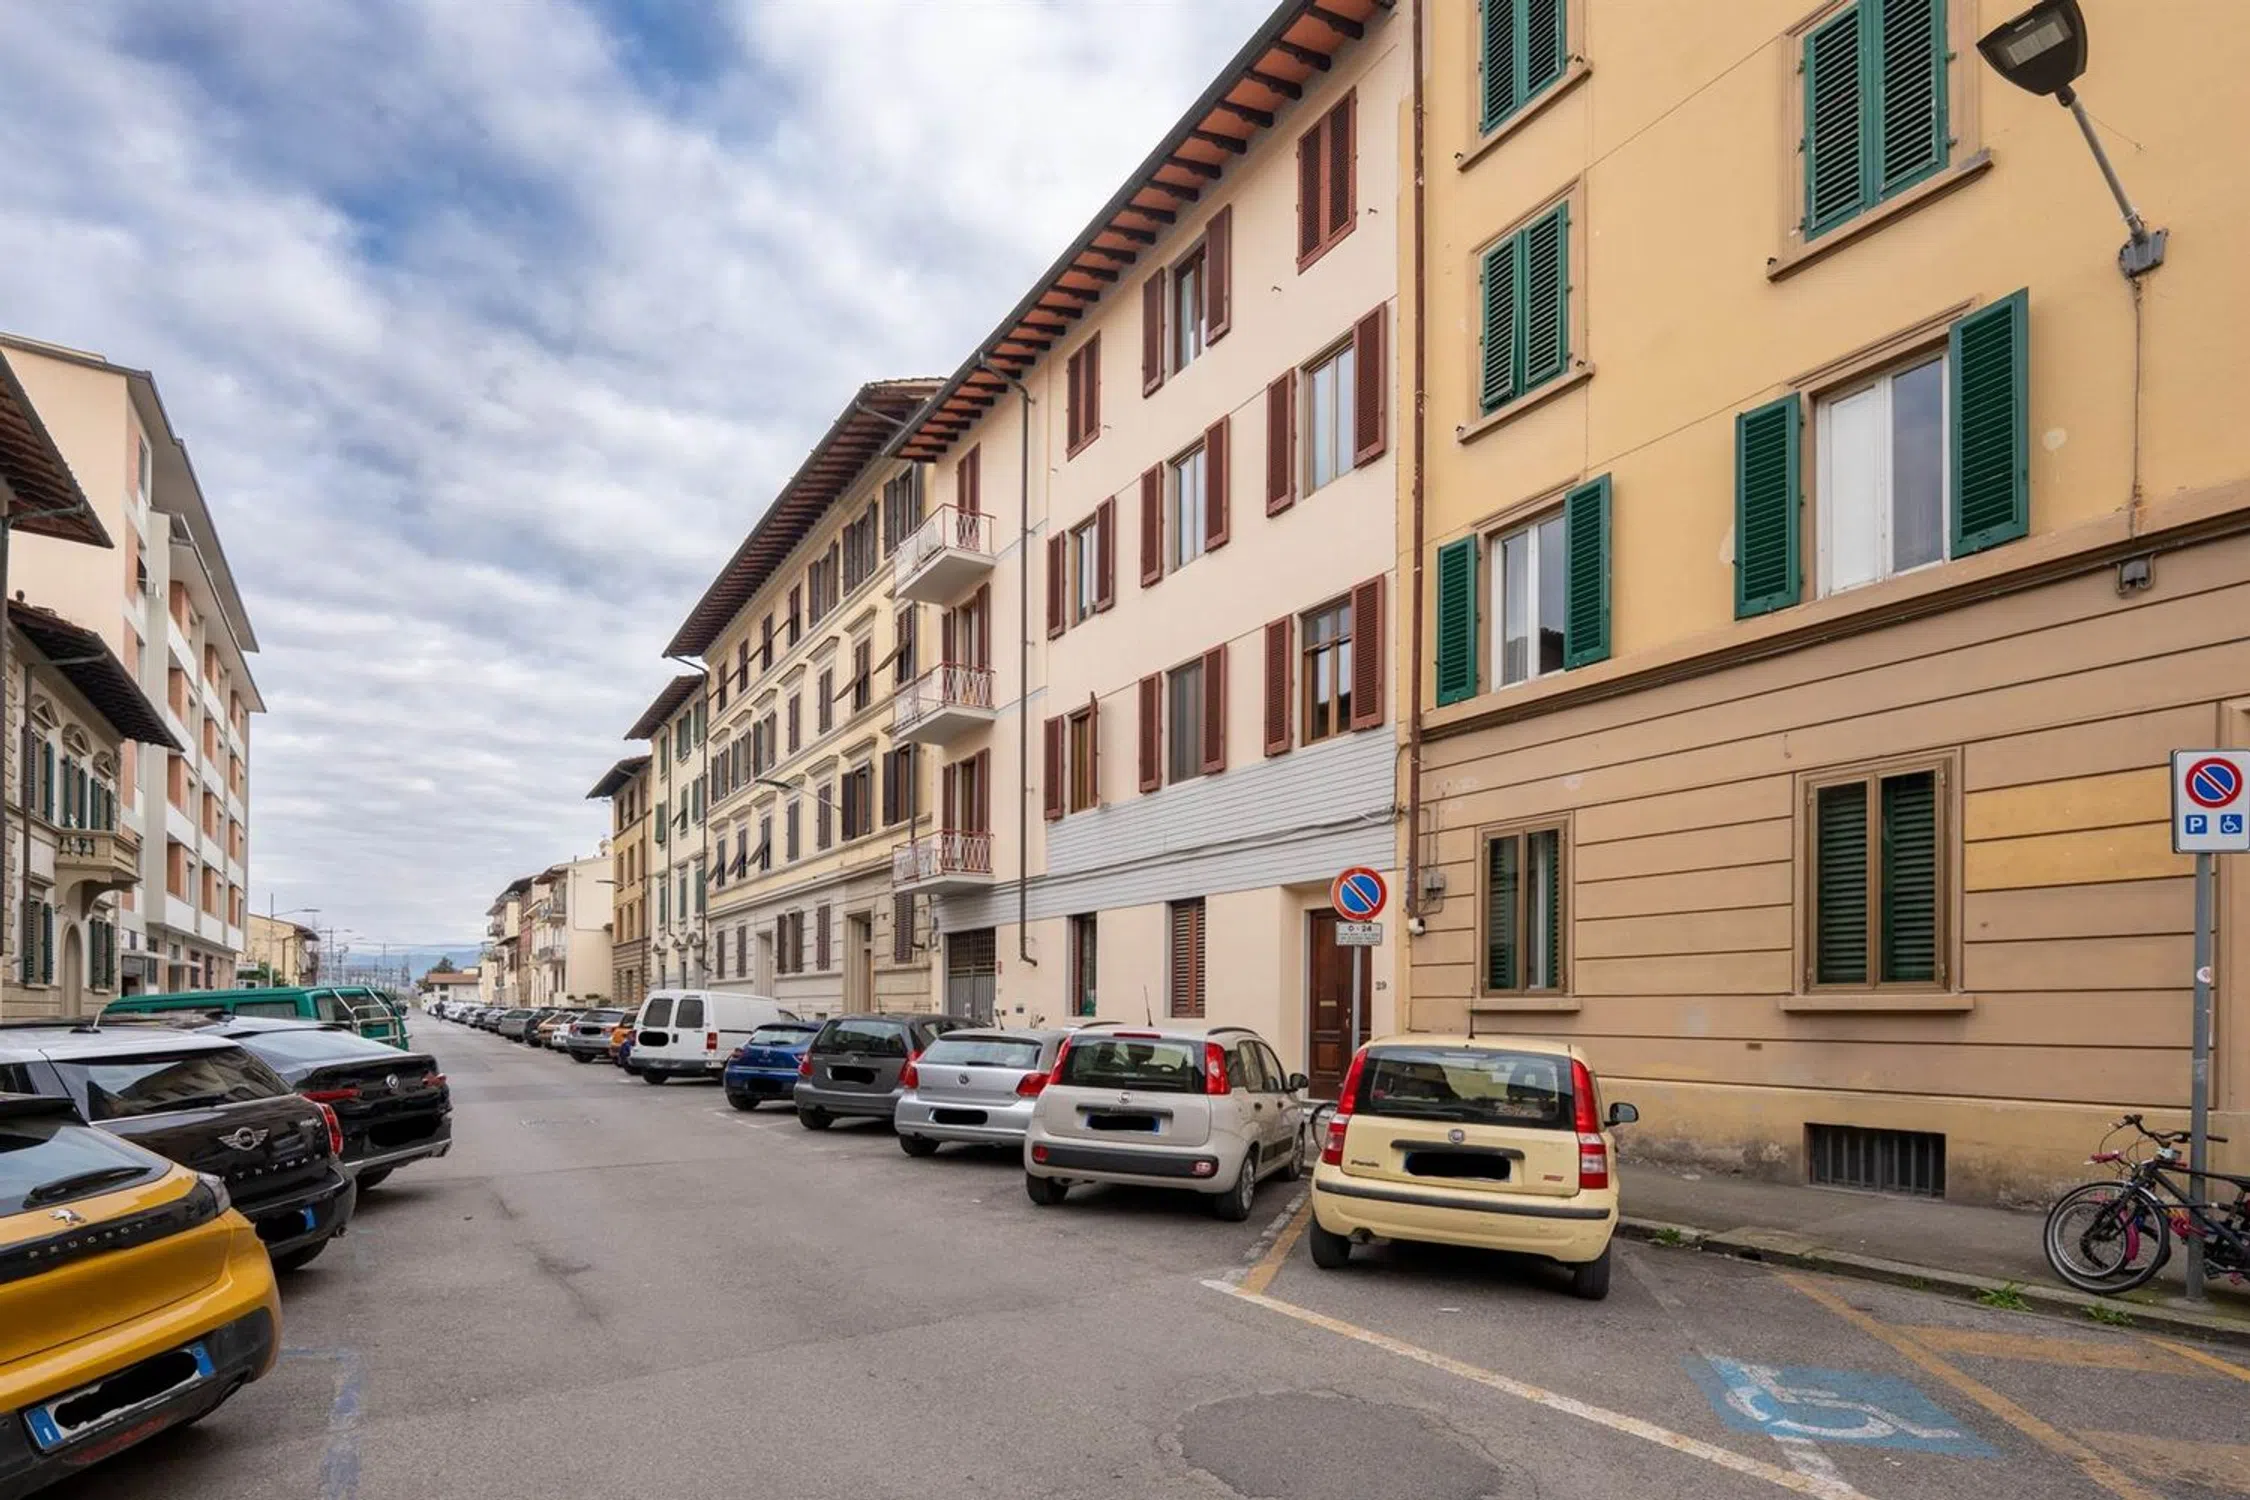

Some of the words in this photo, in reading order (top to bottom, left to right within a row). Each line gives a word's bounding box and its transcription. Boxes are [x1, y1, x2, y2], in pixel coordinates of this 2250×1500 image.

[2190, 817, 2203, 832] P
[1375, 981, 1387, 991] 29
[28, 1222, 143, 1259] PEUGEOT
